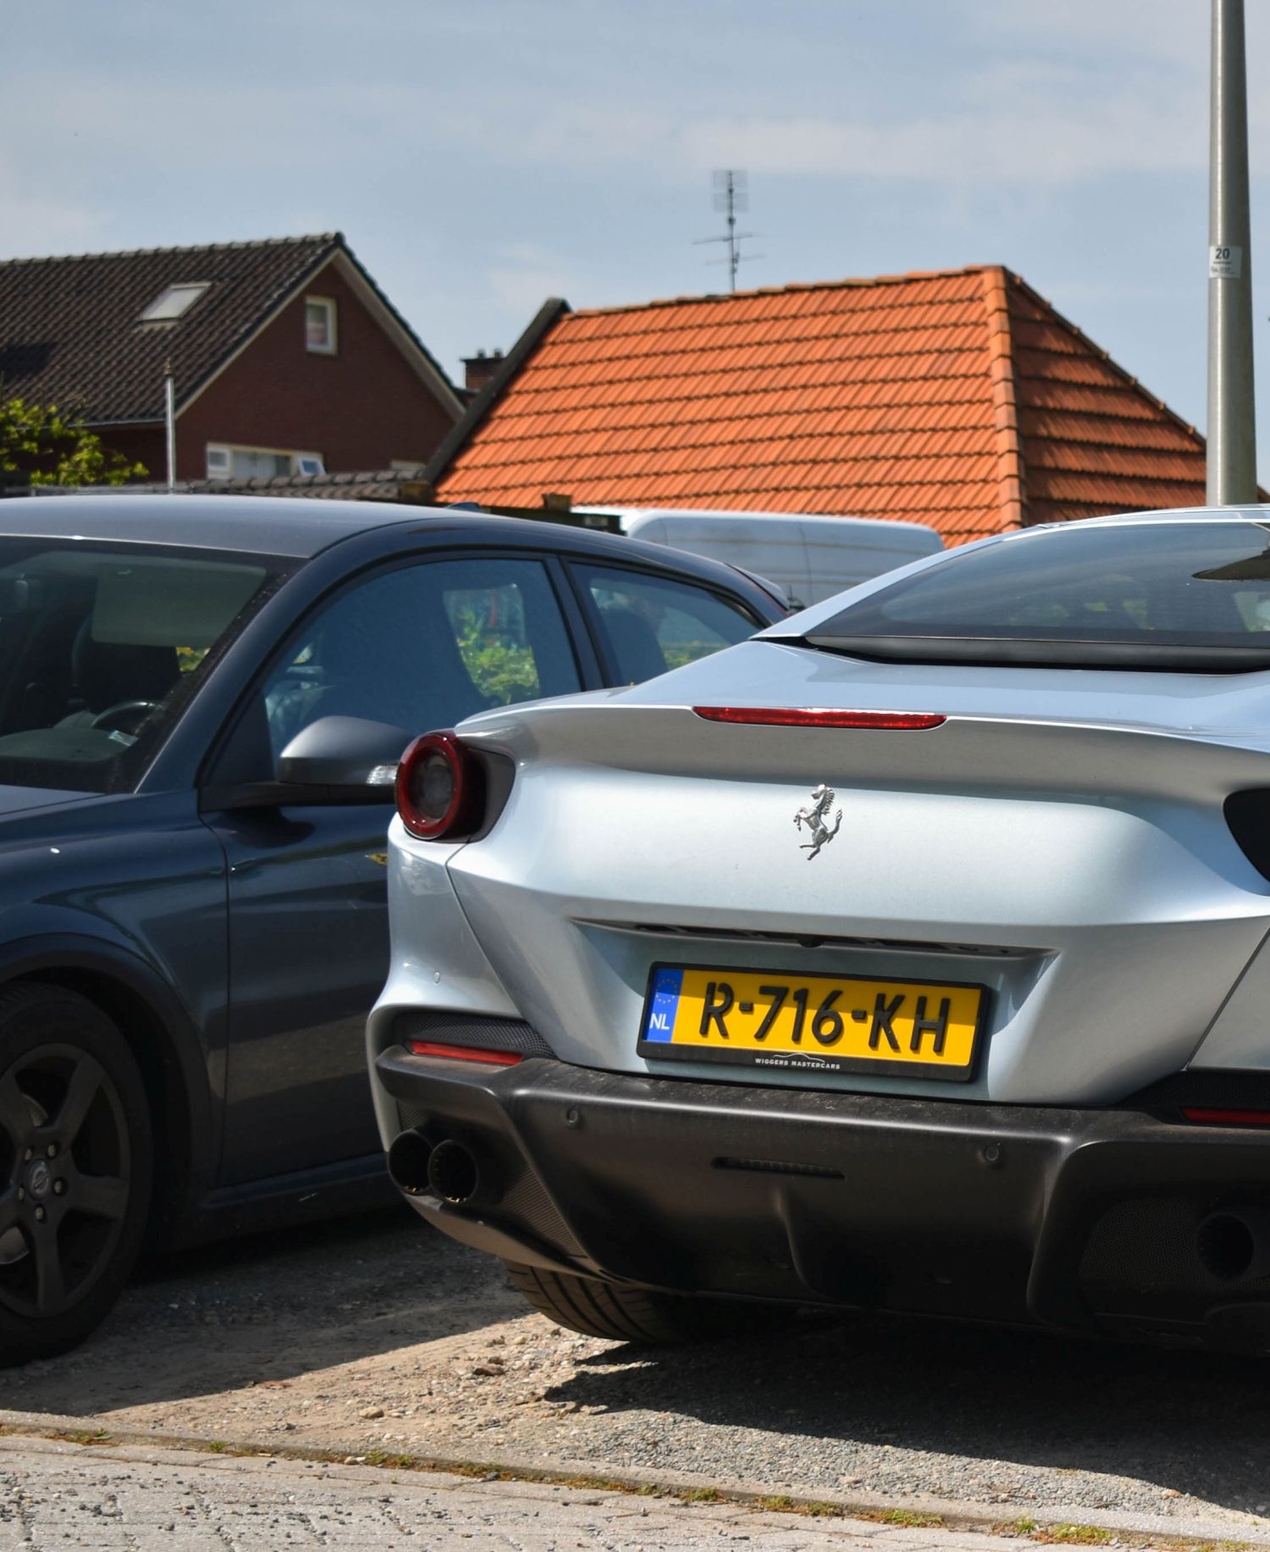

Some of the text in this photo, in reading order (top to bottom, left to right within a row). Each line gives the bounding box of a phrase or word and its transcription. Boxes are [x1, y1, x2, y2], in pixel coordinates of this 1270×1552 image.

[1215, 247, 1230, 260] 20
[650, 1012, 670, 1031] NL
[699, 981, 951, 1053] R-716-KH
[755, 1058, 841, 1070] WIGGERS MASTERCARS
